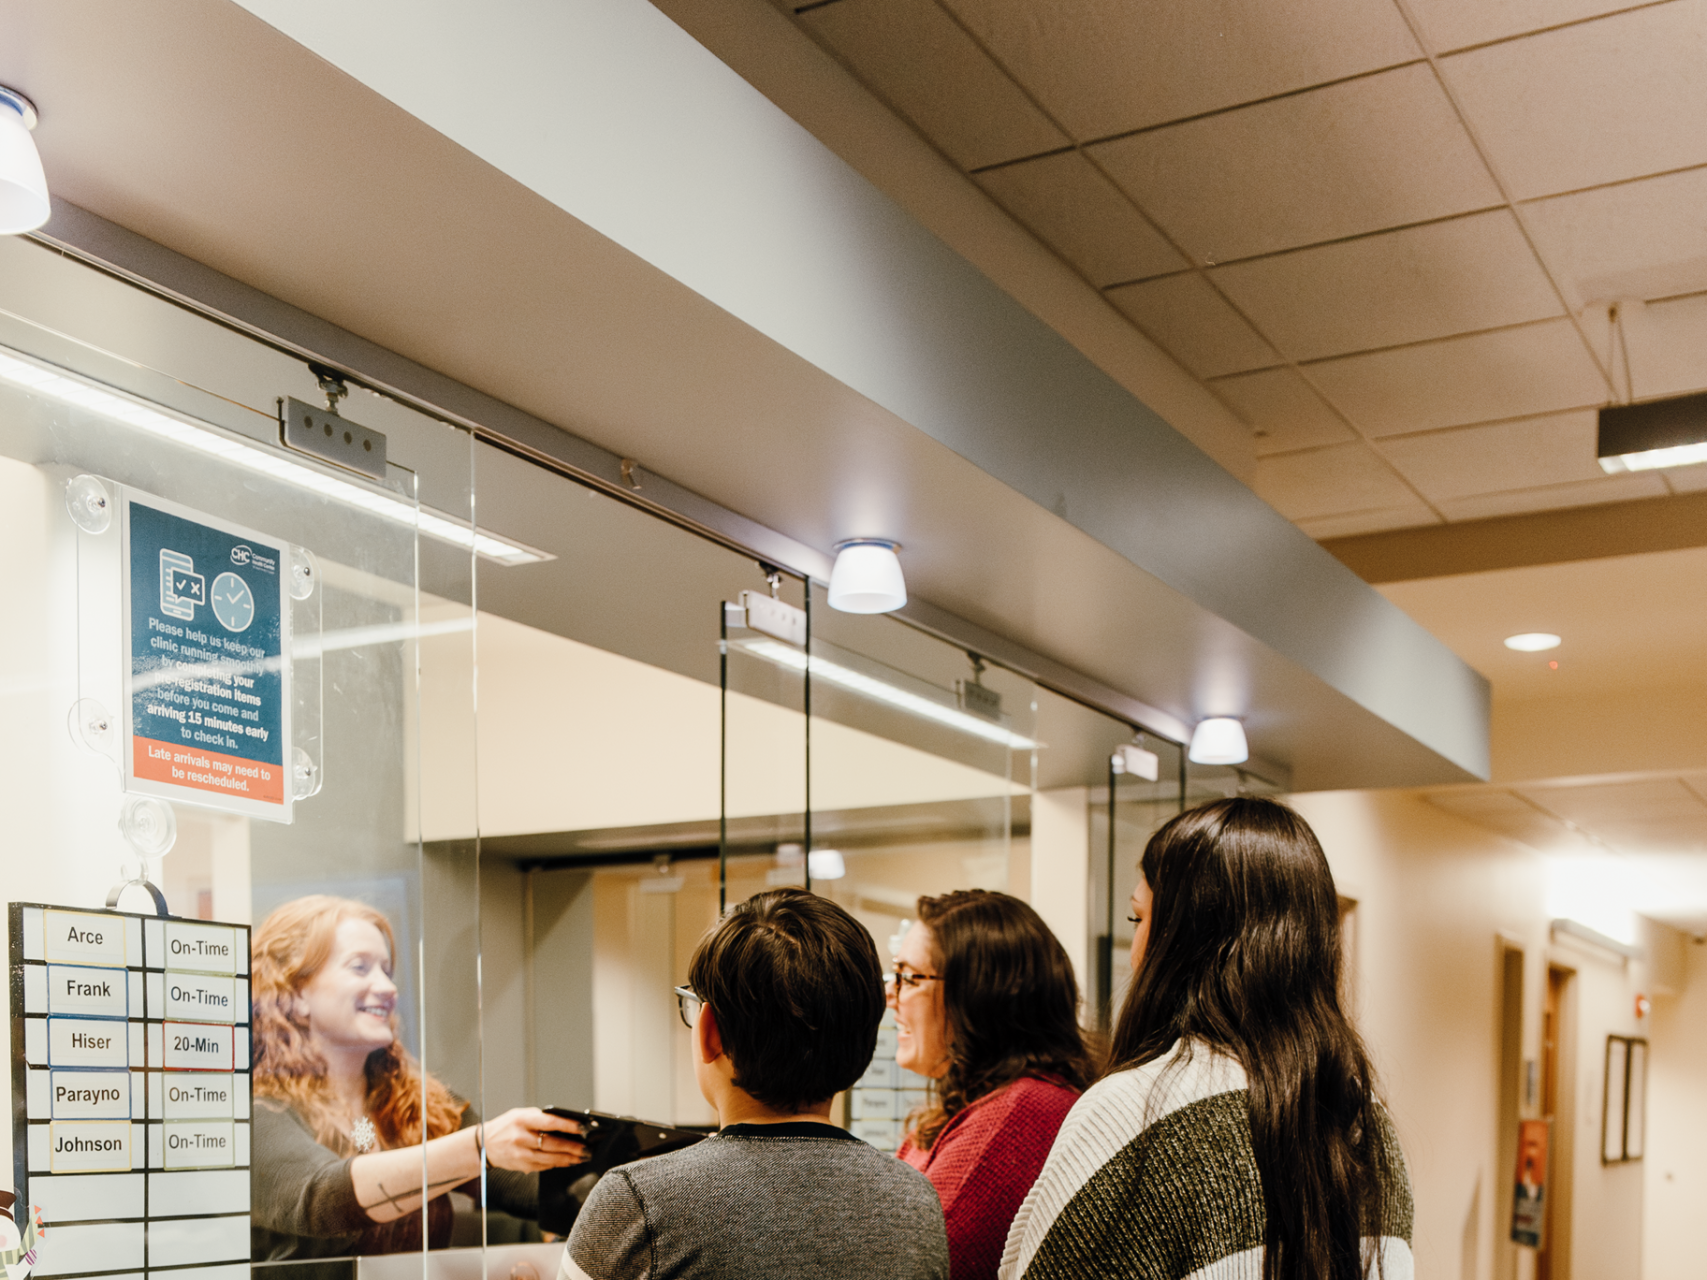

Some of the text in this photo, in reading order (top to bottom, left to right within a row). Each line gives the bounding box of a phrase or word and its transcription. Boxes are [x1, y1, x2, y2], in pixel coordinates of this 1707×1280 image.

[231, 548, 251, 563] CHC
[148, 617, 266, 659] Please help us keep our
[150, 636, 265, 677] clinic running smoothly
[161, 654, 255, 689] by completing your
[154, 672, 262, 707] pre-registration items
[157, 687, 259, 722] before you come and
[147, 704, 269, 742] arriving 15 minutes early
[180, 726, 239, 750] to check in.
[147, 744, 271, 781] Late arrivals may need to
[171, 765, 250, 792] be rescheduled.
[67, 926, 104, 945] Arce
[170, 939, 229, 956] On-Time
[66, 979, 111, 997] Frank
[170, 986, 229, 1007] On-Time
[71, 1032, 112, 1049] Hiser
[173, 1035, 220, 1054] 20-Min
[55, 1085, 121, 1106] Parayno
[168, 1086, 228, 1102] On-Time
[54, 1136, 123, 1153] Johnson
[168, 1134, 227, 1150] On-Time
